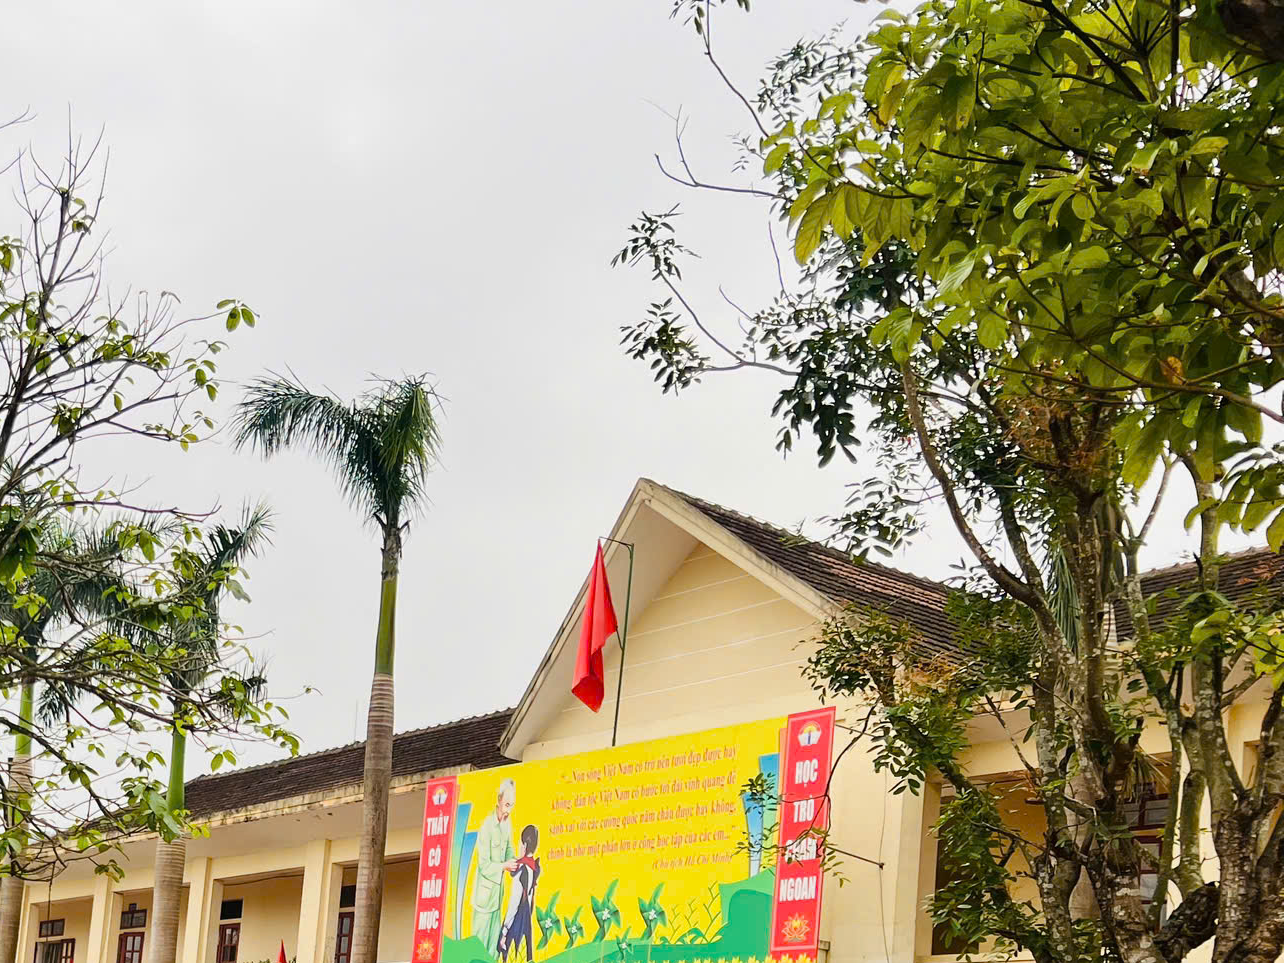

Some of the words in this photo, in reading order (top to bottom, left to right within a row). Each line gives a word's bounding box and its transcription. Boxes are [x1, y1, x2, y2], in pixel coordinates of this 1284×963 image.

[794, 758, 818, 788] HỌC
[793, 794, 815, 823] TRÒ
[426, 809, 449, 836] THẦY
[427, 844, 441, 867] CÔ
[421, 873, 442, 899] MẪU
[779, 875, 816, 902] NGOAN
[418, 907, 440, 933] MỰC
